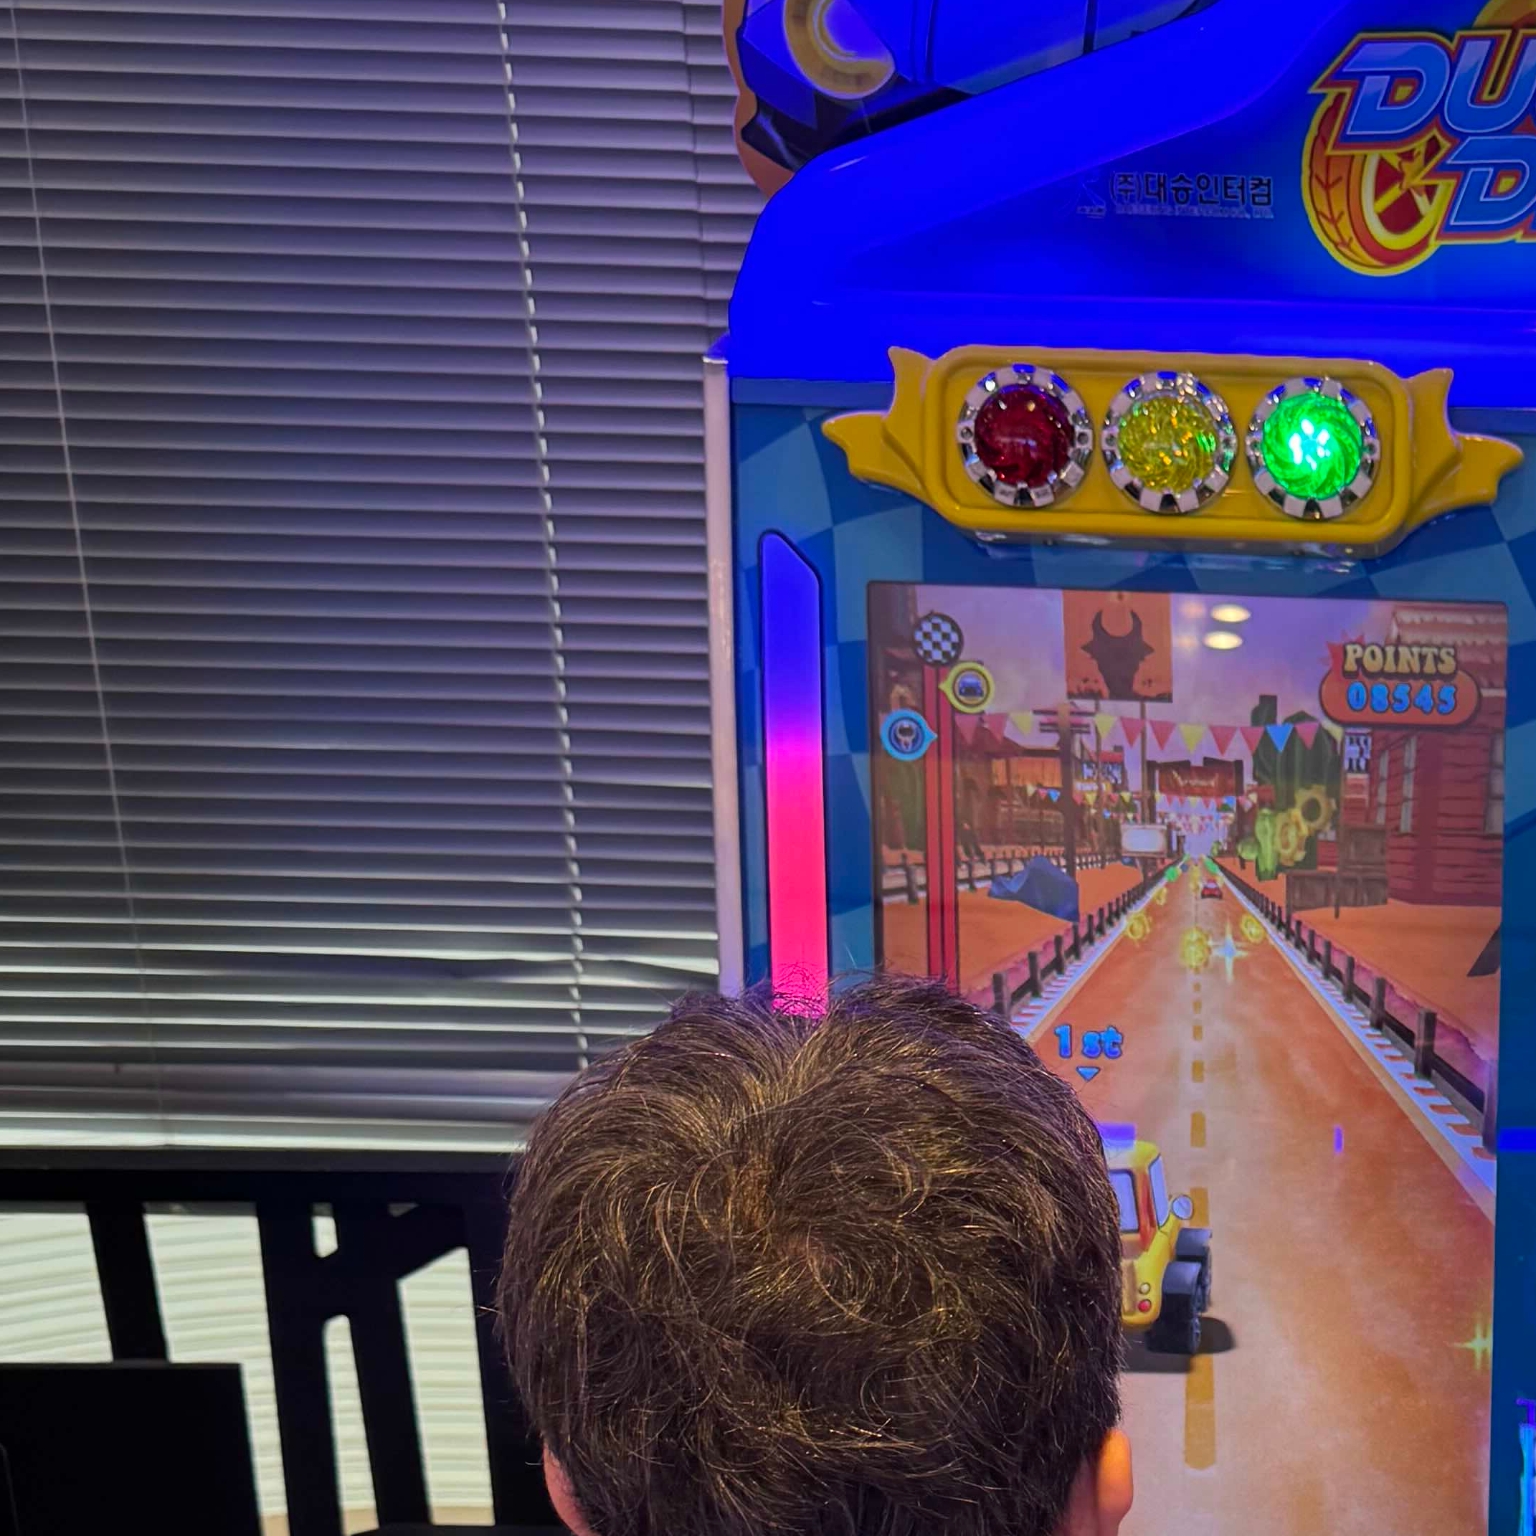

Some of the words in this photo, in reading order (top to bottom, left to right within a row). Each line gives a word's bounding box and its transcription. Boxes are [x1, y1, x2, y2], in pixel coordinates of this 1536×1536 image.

[1110, 172, 1272, 206] (주)대승인터컴
[1343, 643, 1457, 676] POINTS
[1347, 681, 1457, 715] 08545
[1054, 1024, 1124, 1059] 1st
